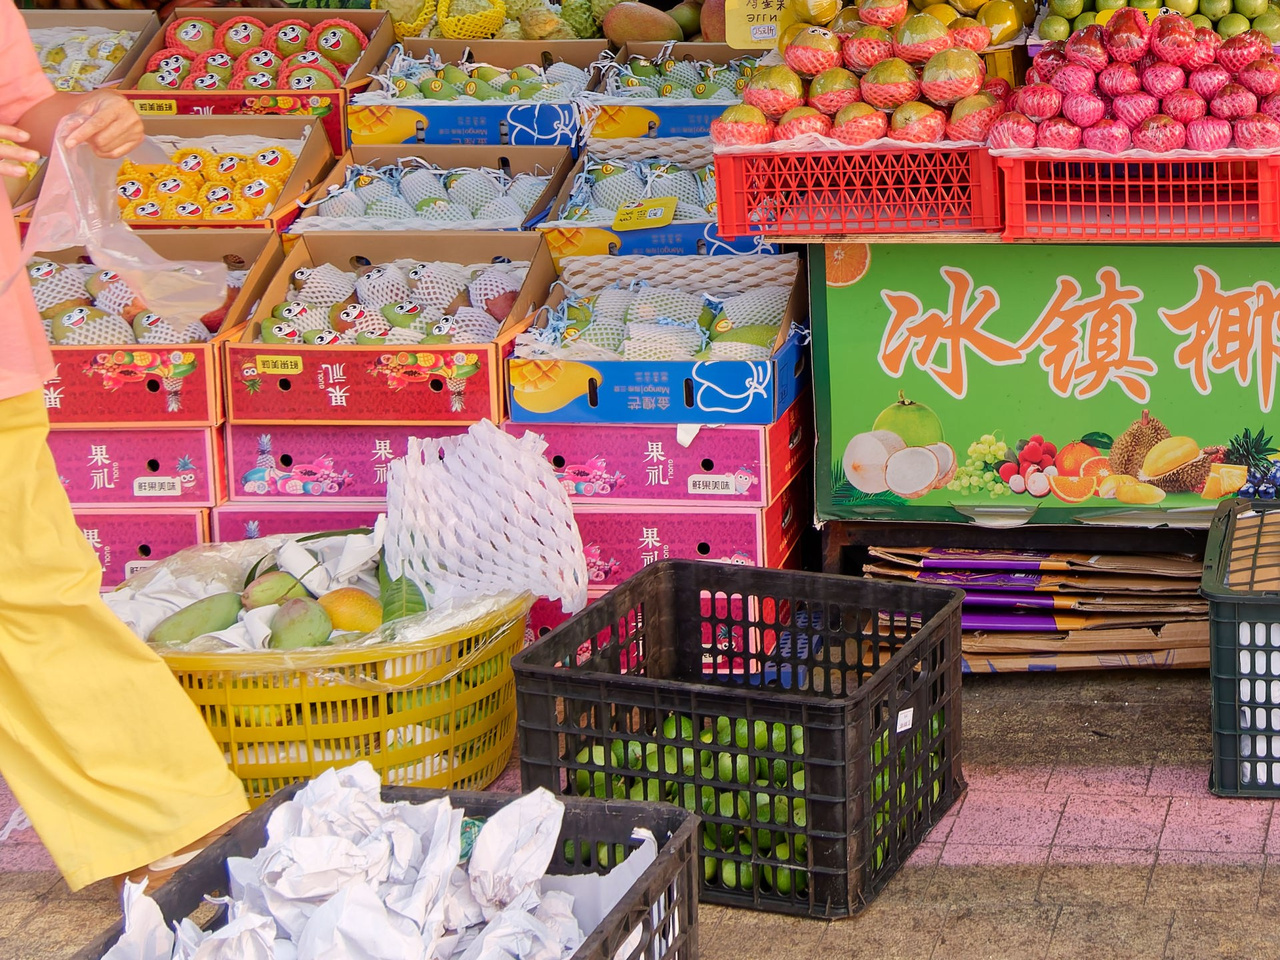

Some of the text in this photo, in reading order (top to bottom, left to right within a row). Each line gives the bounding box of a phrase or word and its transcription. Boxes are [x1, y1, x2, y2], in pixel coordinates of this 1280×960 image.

[138, 103, 173, 112] 鲜果美味
[260, 360, 299, 370] 鲜果美味
[321, 363, 350, 407] 果礼
[643, 384, 670, 394] Mango
[627, 396, 671, 410] 金煌芒
[87, 444, 116, 491] 果礼
[643, 440, 669, 487] 果礼
[138, 482, 177, 493] 鲜果美味
[692, 479, 731, 491] 鲜果美味
